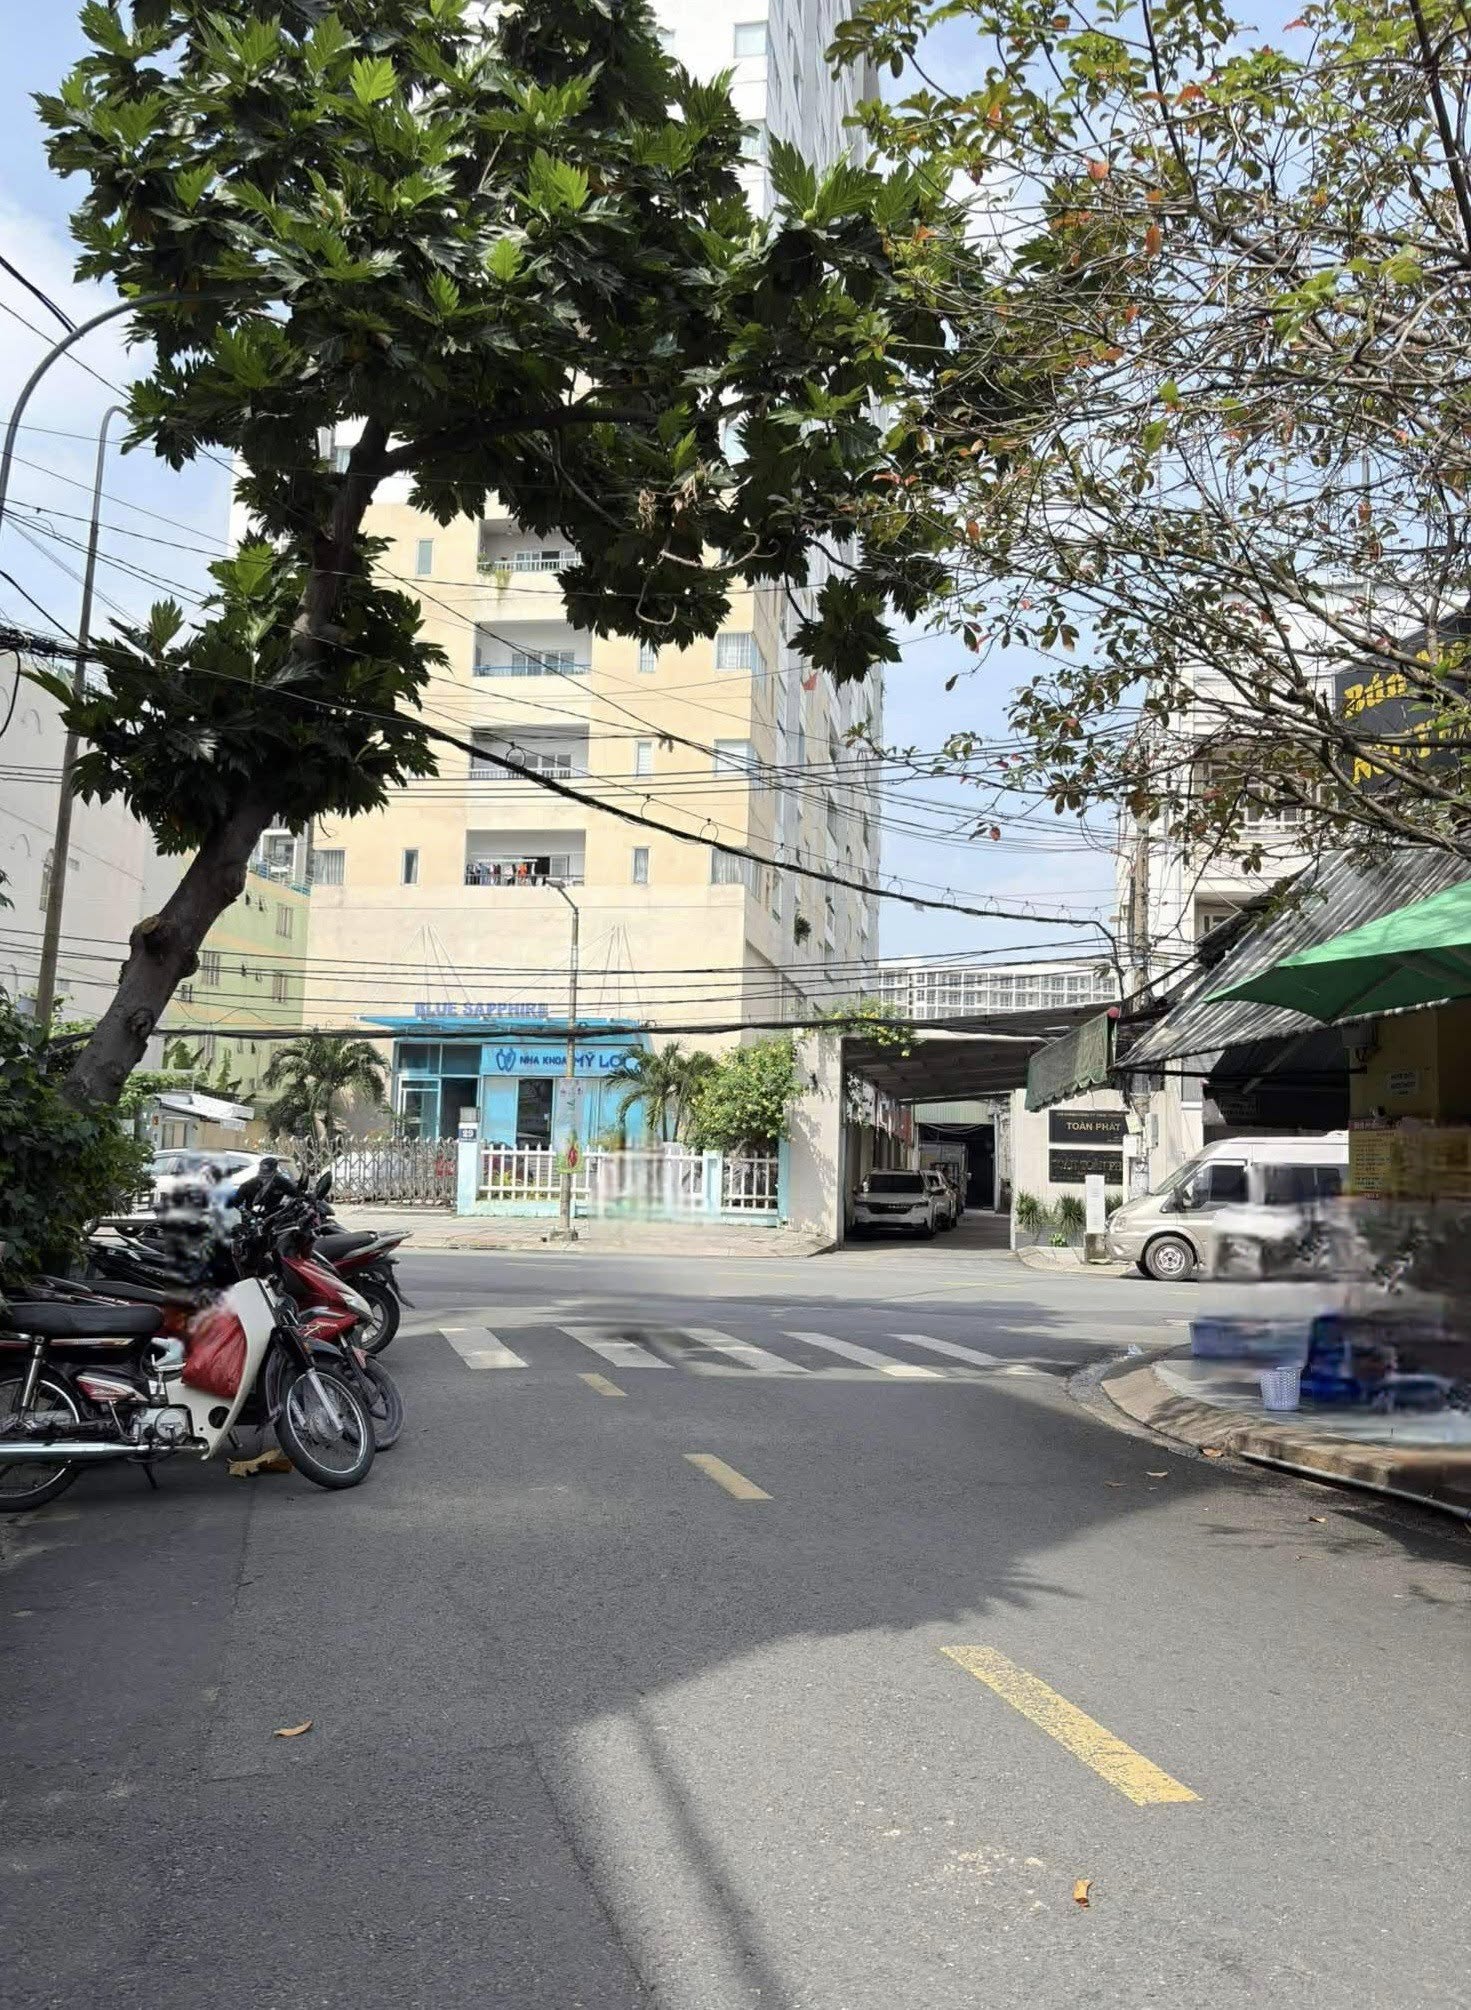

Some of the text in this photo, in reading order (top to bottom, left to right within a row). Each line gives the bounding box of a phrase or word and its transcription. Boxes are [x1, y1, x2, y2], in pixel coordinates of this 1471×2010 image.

[414, 1002, 548, 1018] BLUE SAPPHIRE
[520, 1055, 539, 1065] NHA
